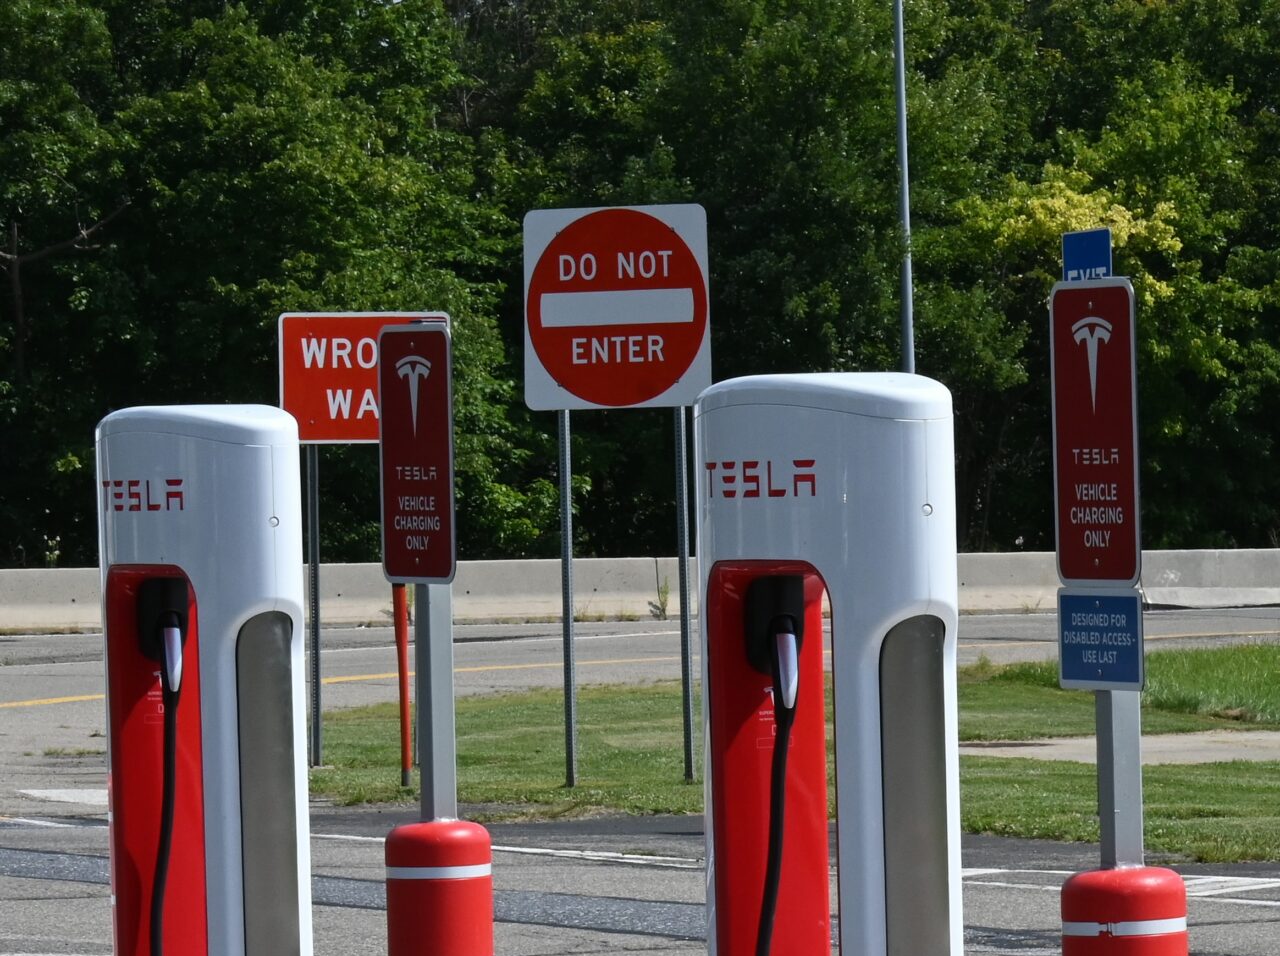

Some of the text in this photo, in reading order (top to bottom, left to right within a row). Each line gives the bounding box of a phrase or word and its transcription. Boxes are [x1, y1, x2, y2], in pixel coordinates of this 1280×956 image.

[559, 250, 673, 281] DO NOT
[301, 337, 378, 369] WRO
[572, 335, 664, 365] ENTER
[326, 388, 379, 420] WA
[1072, 448, 1119, 465] TESLA
[395, 466, 437, 480] TESLA
[705, 459, 816, 498] TESLA
[102, 479, 184, 512] TESLA
[1075, 484, 1118, 501] VEHICLE
[398, 496, 435, 511] VEHICLE
[394, 515, 441, 531] CHARGING
[1070, 507, 1124, 524] CHARGING
[405, 535, 429, 550] ONLY
[1083, 530, 1111, 548] ONLY
[1071, 613, 1127, 628] DESIGNED FOR
[1063, 631, 1100, 645] DISABLED
[1082, 649, 1118, 664] USE LAST
